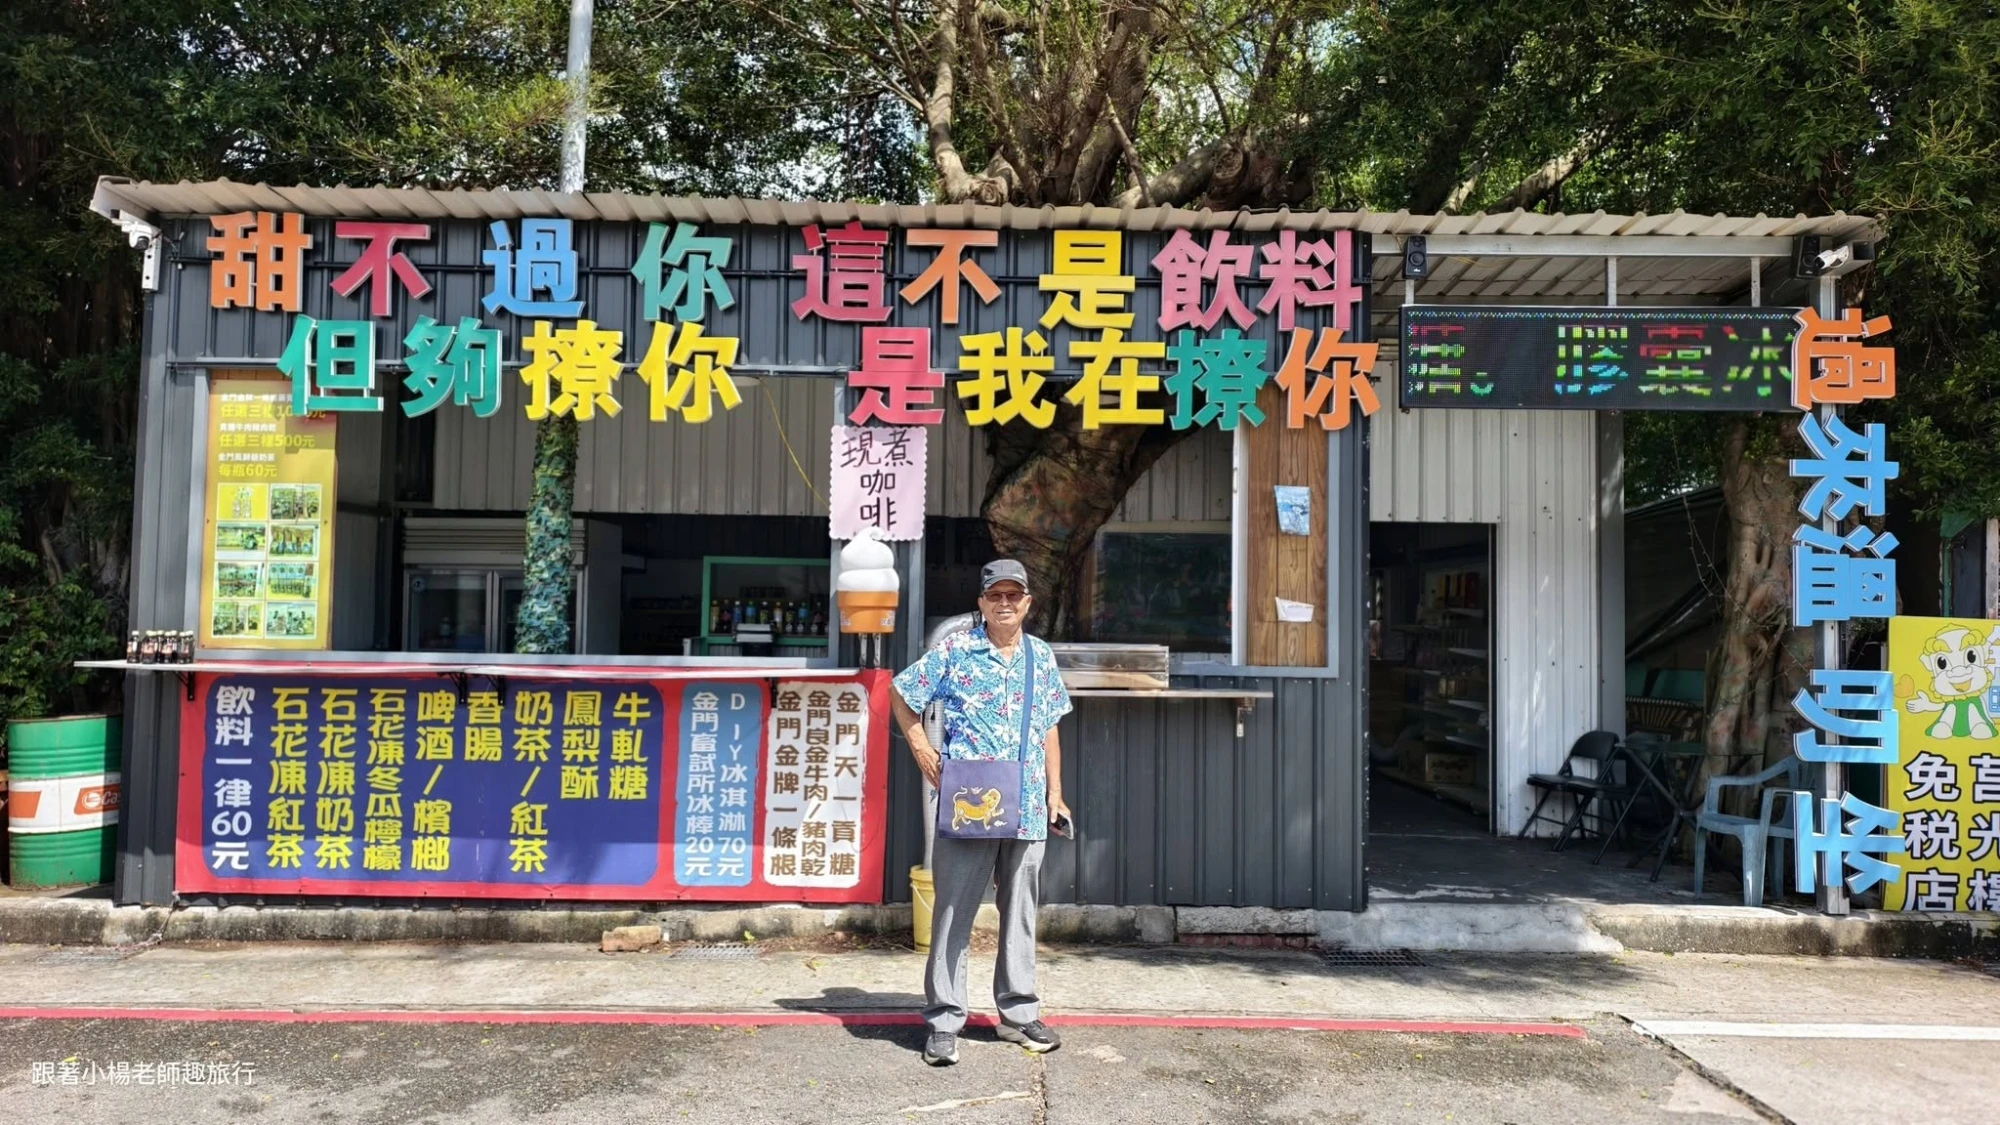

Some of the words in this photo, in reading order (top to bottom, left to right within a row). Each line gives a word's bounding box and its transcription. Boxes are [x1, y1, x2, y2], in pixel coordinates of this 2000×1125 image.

[207, 211, 736, 321] 甜不過你
[792, 220, 1362, 332] 這不是飲料
[277, 314, 742, 423] 但夠撩你
[848, 327, 1382, 431] 是我在撩你
[840, 429, 914, 468] 現煮
[211, 685, 254, 870] 飲料一律60元
[266, 686, 309, 869] 石花凍紅茶
[314, 686, 358, 870] 石花凍奶茶
[363, 687, 406, 871] 石花凍冬瓜檸檬
[464, 691, 503, 762] 香腸
[560, 690, 602, 799] 鳳梨酥
[608, 692, 651, 800] 牛軋糖
[770, 690, 801, 876] 金門金牌一條根
[829, 691, 861, 876] 金門天一貢糖
